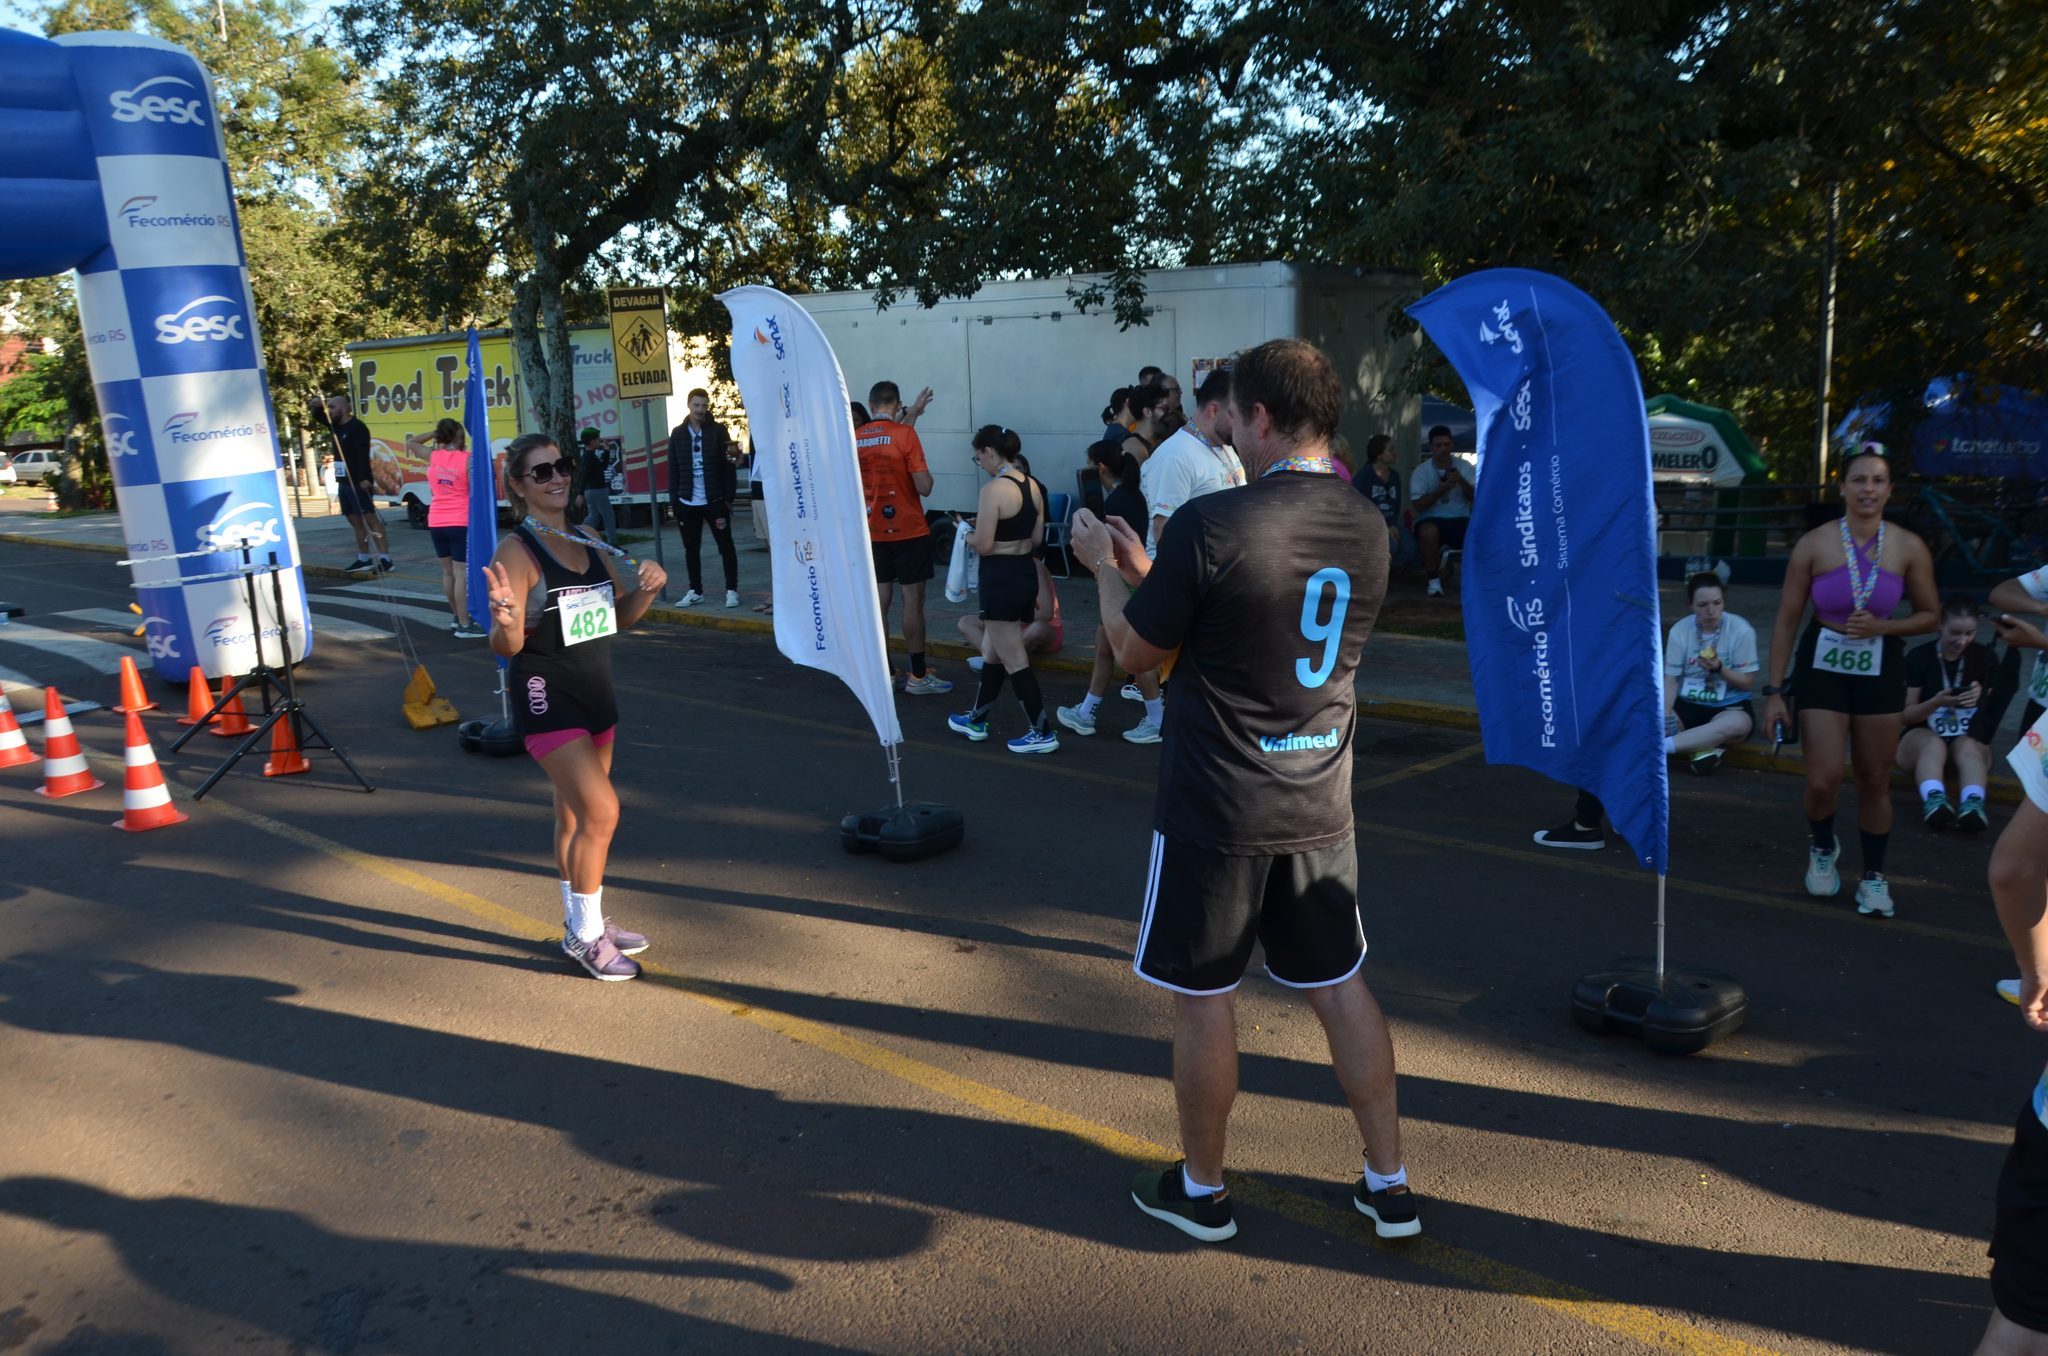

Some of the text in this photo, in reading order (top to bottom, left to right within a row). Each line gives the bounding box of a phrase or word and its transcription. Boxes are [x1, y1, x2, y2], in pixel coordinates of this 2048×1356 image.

[110, 90, 205, 126] Sesc
[129, 213, 231, 228] Fecomércio RS
[613, 294, 660, 308] DEVAGAR
[155, 313, 244, 344] Sesc
[360, 360, 423, 415] Food
[436, 355, 512, 411] Trck
[621, 369, 668, 387] ELEVADA
[171, 422, 268, 444] Fecomércio RS
[856, 435, 891, 448] ARQUETTI
[789, 442, 806, 519] Sindicatos
[1514, 461, 1539, 568] Sindicatos
[1550, 455, 1569, 569] Sistema Comércio
[803, 541, 815, 562] RS
[570, 607, 609, 639] 482
[807, 566, 826, 651] Fecomércio
[1526, 598, 1546, 626] RS
[1295, 567, 1350, 688] 9
[1823, 647, 1873, 672] 468
[1532, 631, 1556, 748] Fecomércio
[1259, 728, 1338, 753] Unimed
